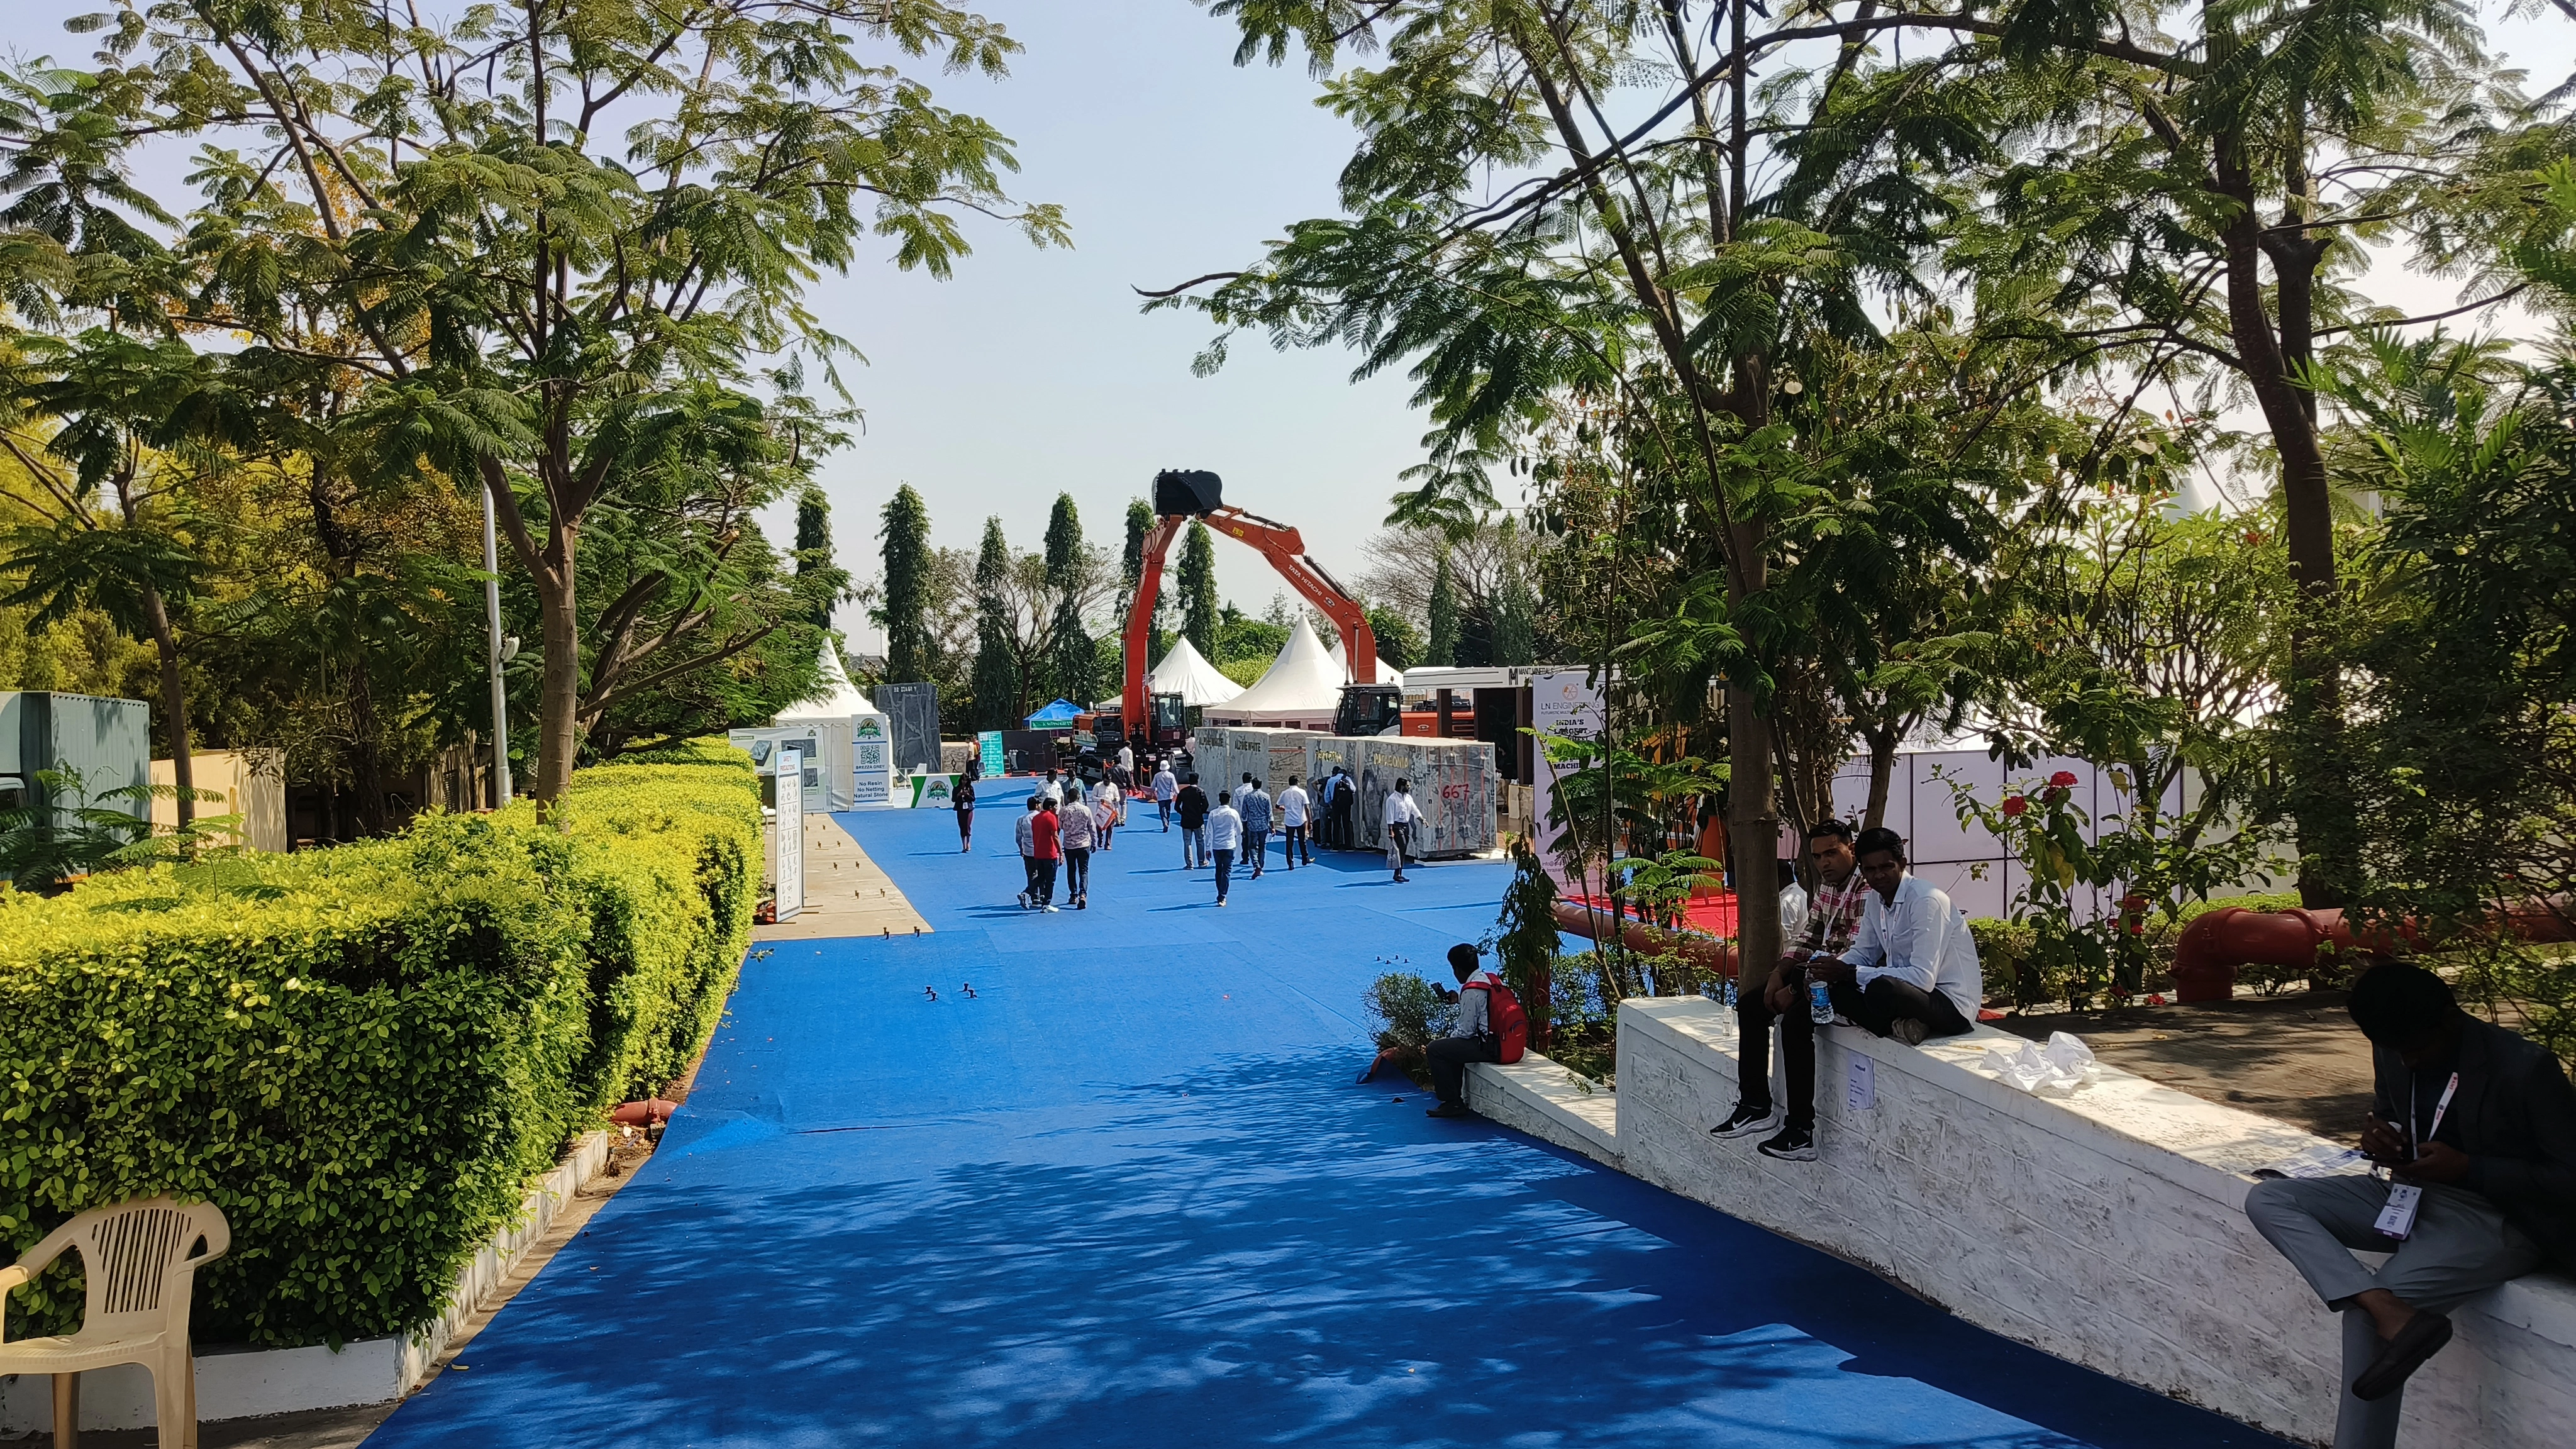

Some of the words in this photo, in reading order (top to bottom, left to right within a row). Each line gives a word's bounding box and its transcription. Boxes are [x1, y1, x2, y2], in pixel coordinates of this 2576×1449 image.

[1288, 564, 1301, 578] TATA
[1301, 576, 1323, 596] HITACHI
[1553, 701, 1600, 709] ENGINEING
[1374, 753, 1409, 769] PATAGONIA
[1442, 783, 1470, 801] 667
